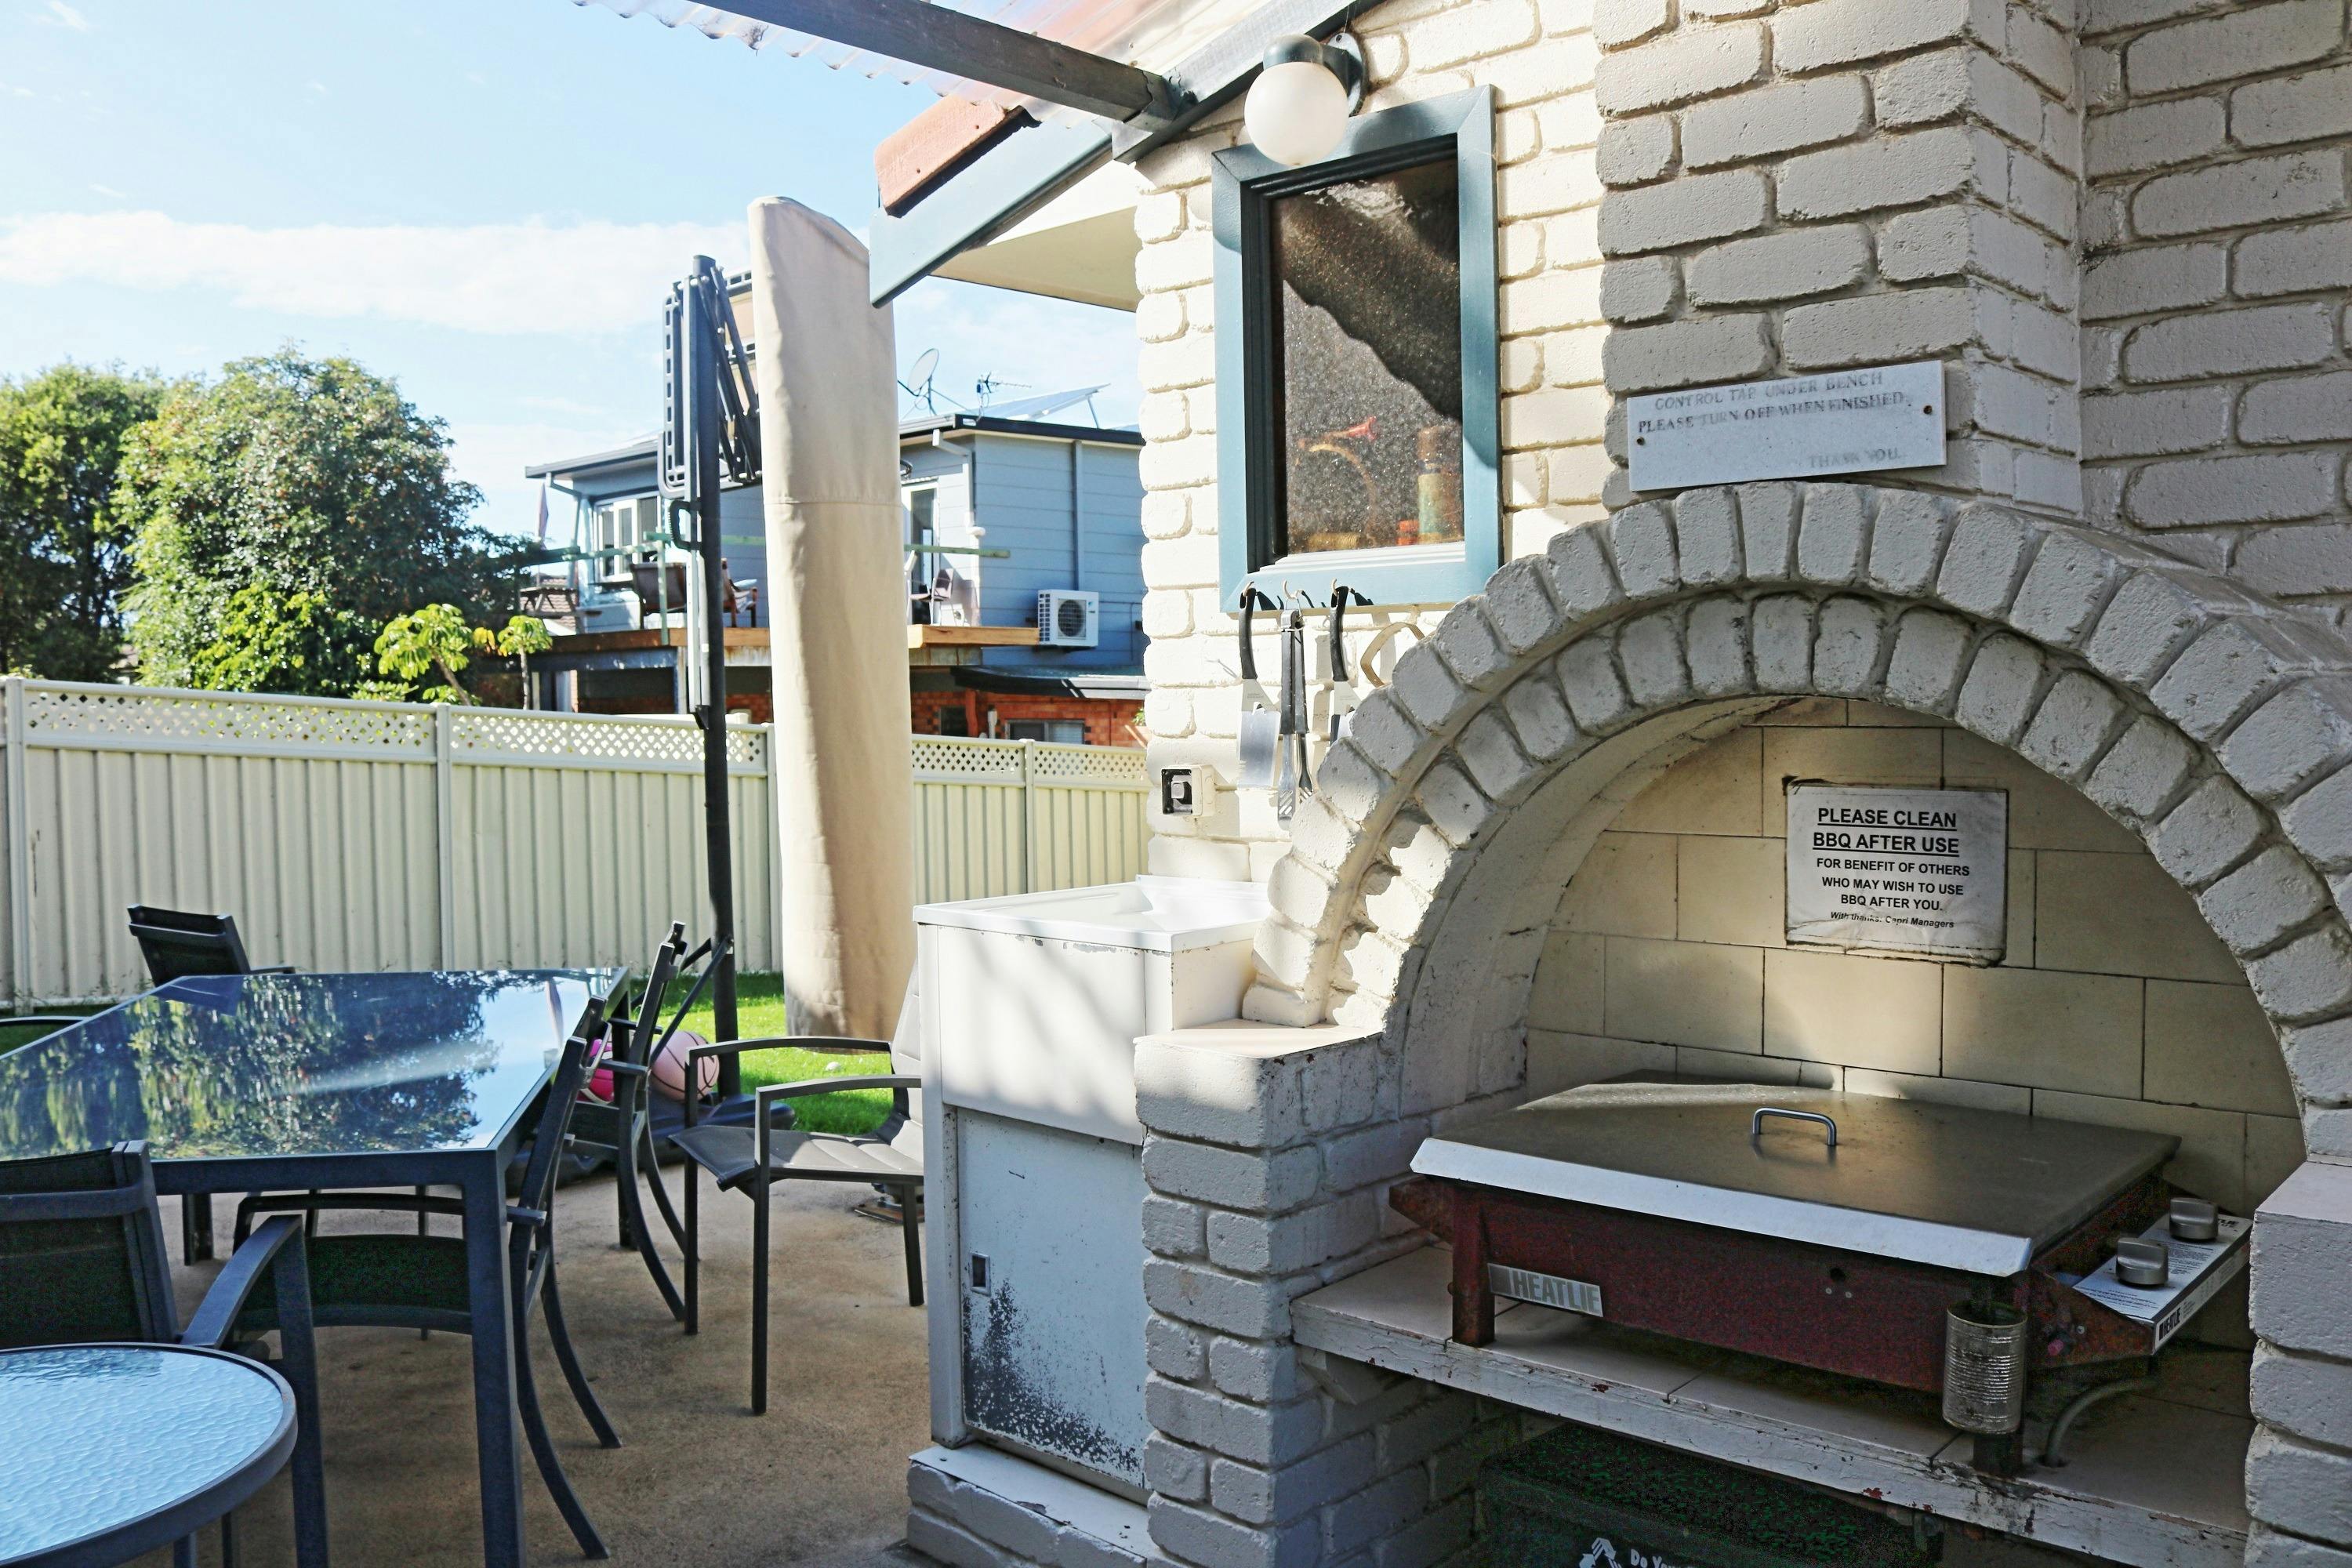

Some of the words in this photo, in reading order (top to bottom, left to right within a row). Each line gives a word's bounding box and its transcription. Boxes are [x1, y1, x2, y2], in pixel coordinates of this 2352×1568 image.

[1654, 392, 1723, 411] CONTROL
[1729, 387, 1756, 401] TAP
[1638, 416, 1694, 433] PLEASE
[1744, 406, 1774, 420] OFF
[1779, 400, 1825, 417] WHEN
[1817, 808, 1889, 826] PLEASE
[1893, 810, 1957, 828] CLEAN
[1813, 832, 1852, 848] BBQ
[1856, 834, 1915, 851] AFTER
[1922, 837, 1959, 854] USE
[1817, 858, 1842, 869] FOR
[1844, 860, 1896, 872] BENEFIT
[1898, 862, 1915, 873] OF
[1918, 863, 1970, 877] OTHERS
[1822, 877, 1850, 888] WHO
[1853, 879, 1880, 891] MAY
[1882, 880, 1915, 893] WISH
[1918, 883, 1936, 894] TO
[1938, 884, 1964, 895] USE
[1841, 895, 1867, 906] BBQ
[1869, 897, 1910, 909] AFTER
[1913, 899, 1944, 912] YOU.
[1831, 911, 1849, 920] With
[1911, 917, 1955, 928] Managers
